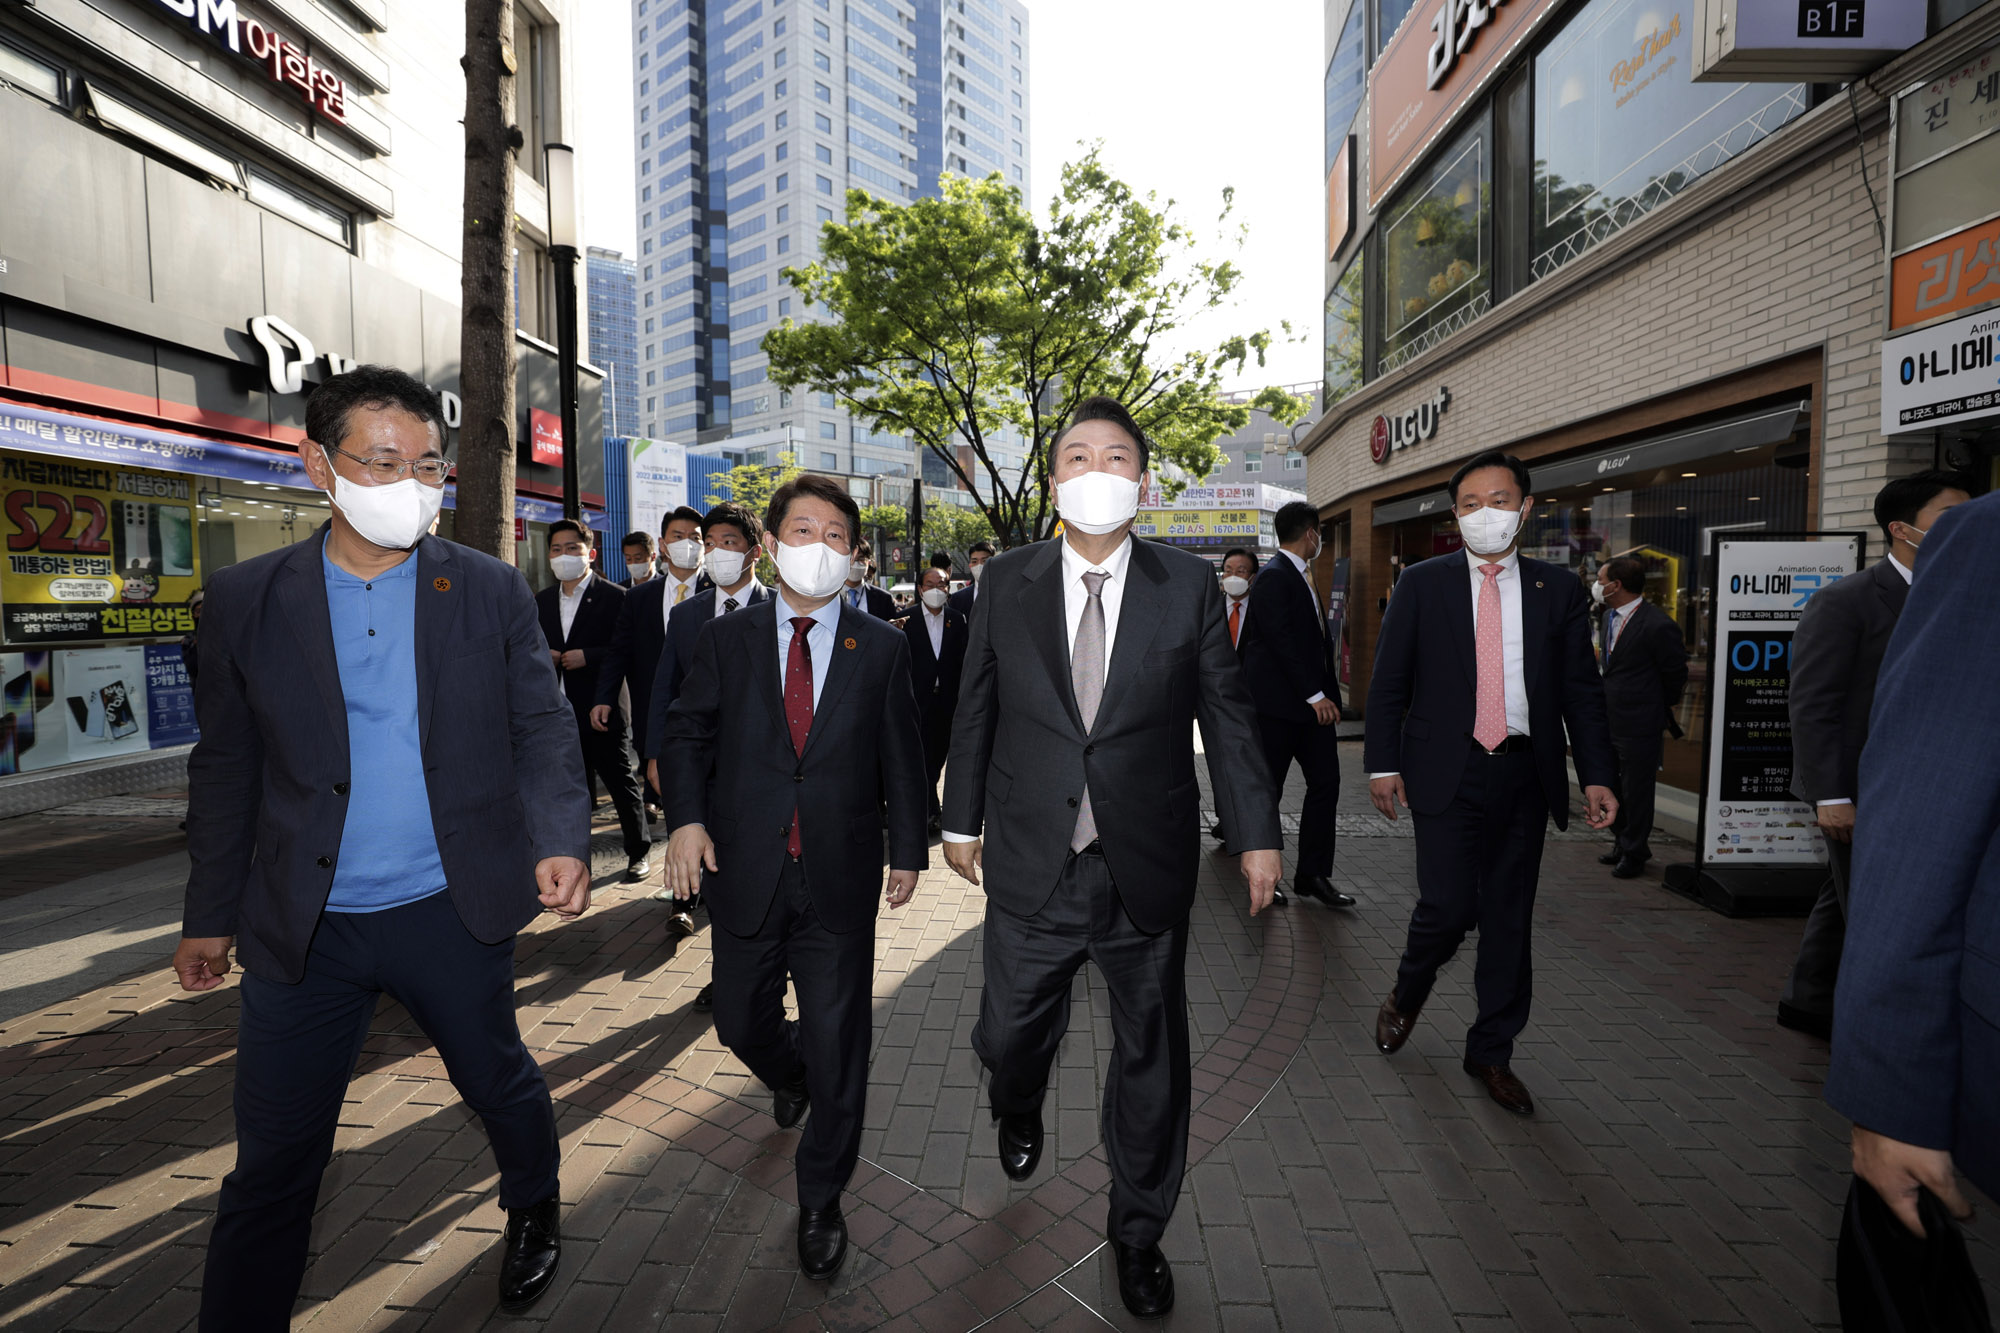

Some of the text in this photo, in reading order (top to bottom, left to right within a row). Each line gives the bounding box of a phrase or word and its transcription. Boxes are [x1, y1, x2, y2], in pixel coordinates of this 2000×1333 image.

[1806, 1, 1859, 32] B1F
[159, 0, 349, 126] M어학원
[1900, 334, 2000, 386] 아니메
[15, 417, 59, 441] 매달
[62, 425, 137, 450] 할인받고
[140, 440, 206, 461] 쇼핑하자
[2, 457, 113, 491] 자급제보다
[117, 471, 190, 500] 저렴하게
[1182, 488, 1214, 499] 대한민국
[5, 489, 110, 556] S22
[1135, 513, 1153, 523] 고폰
[1173, 513, 1200, 523] 아이폰
[1221, 513, 1247, 523] 선불폰
[1168, 525, 1205, 534] 수리 A/S
[1213, 525, 1256, 534] 1670-1183
[8, 555, 112, 576] 개통하는 방법!
[1778, 565, 1844, 573] Animation Goods
[100, 608, 195, 634] 친절상담
